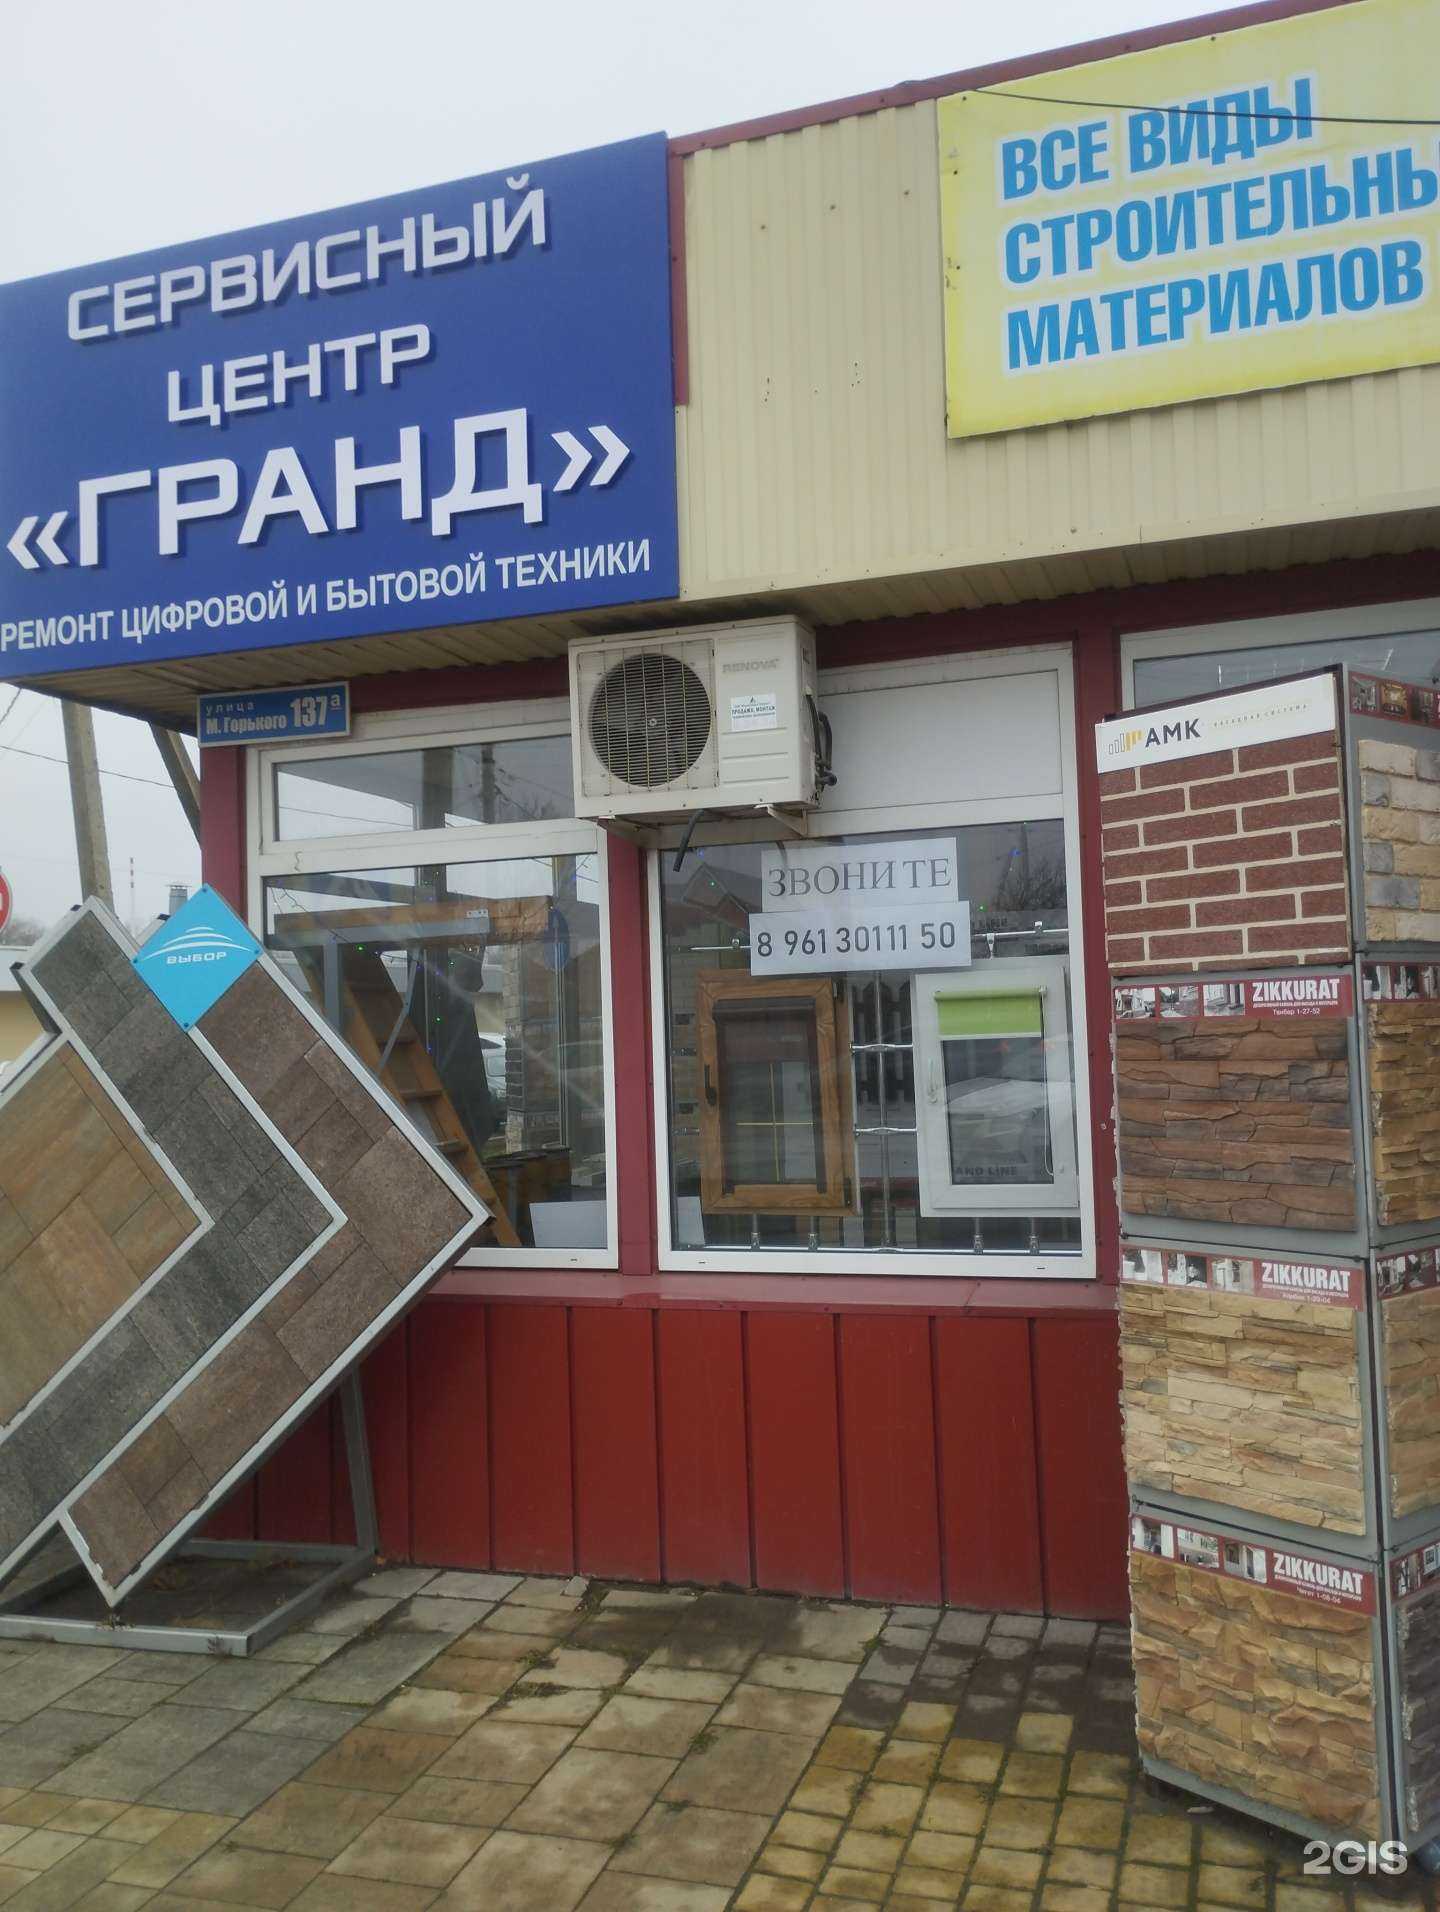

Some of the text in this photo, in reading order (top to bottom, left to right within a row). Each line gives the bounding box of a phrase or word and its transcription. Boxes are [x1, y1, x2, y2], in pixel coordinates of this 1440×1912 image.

[1002, 78, 1313, 200] ВСЕ ВИДЫ
[67, 173, 548, 341] СЕРВИСНЫЙ
[1007, 240, 1424, 370] МАТЕРИАЛОВ
[167, 323, 431, 427] ЦЕНТР
[6, 407, 631, 569] «ГРАНД»
[0, 539, 650, 651] РЕМОНТ ЦИФРОВОЙ И БЫТОВОЙ ТЕХНИКИ
[206, 702, 254, 716] улица
[1145, 718, 1202, 748] АМК
[768, 858, 952, 897] ЗВОНИТЕ
[167, 952, 227, 964] ВЫБОР
[757, 931, 773, 957] 8
[921, 921, 955, 949] 50
[1252, 979, 1340, 1002] ZIKKURAT
[1261, 1262, 1350, 1292] ZIKKURAT
[1273, 1552, 1363, 1595] ZIKKURAT
